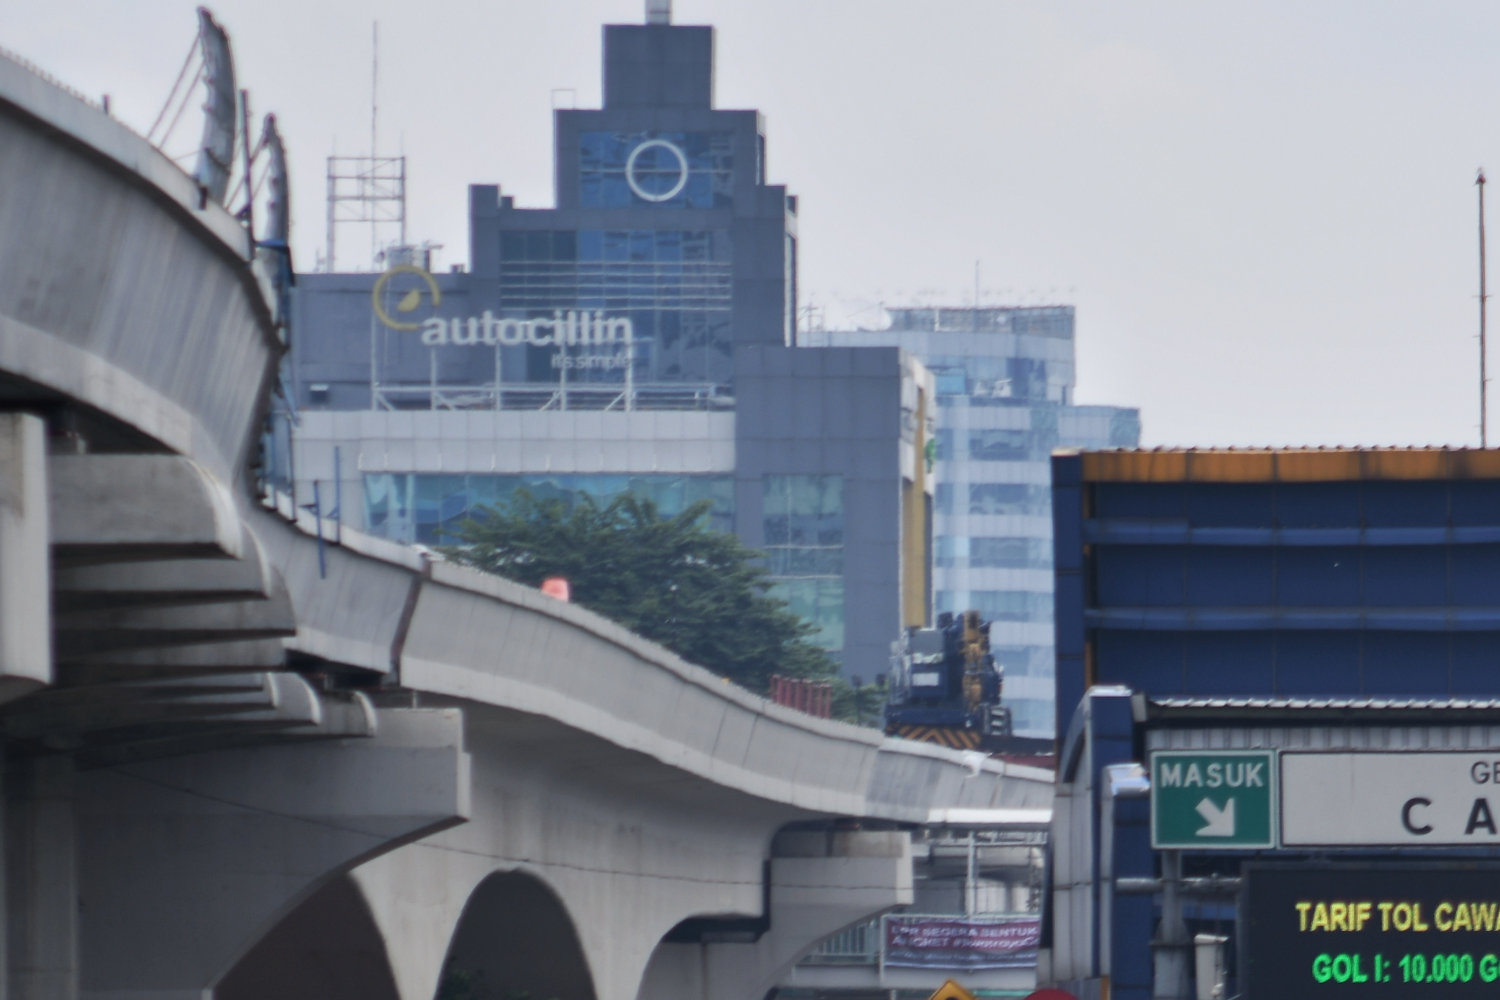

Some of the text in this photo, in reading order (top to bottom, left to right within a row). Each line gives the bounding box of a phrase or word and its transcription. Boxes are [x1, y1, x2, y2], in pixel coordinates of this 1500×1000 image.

[421, 309, 632, 347] autocillin
[1161, 762, 1264, 788] MASUK
[1295, 901, 1371, 932] TARIF
[1378, 901, 1428, 932] TOL
[1312, 953, 1368, 983] GOL
[1375, 953, 1390, 983] I:
[1399, 953, 1474, 983] 10.000
